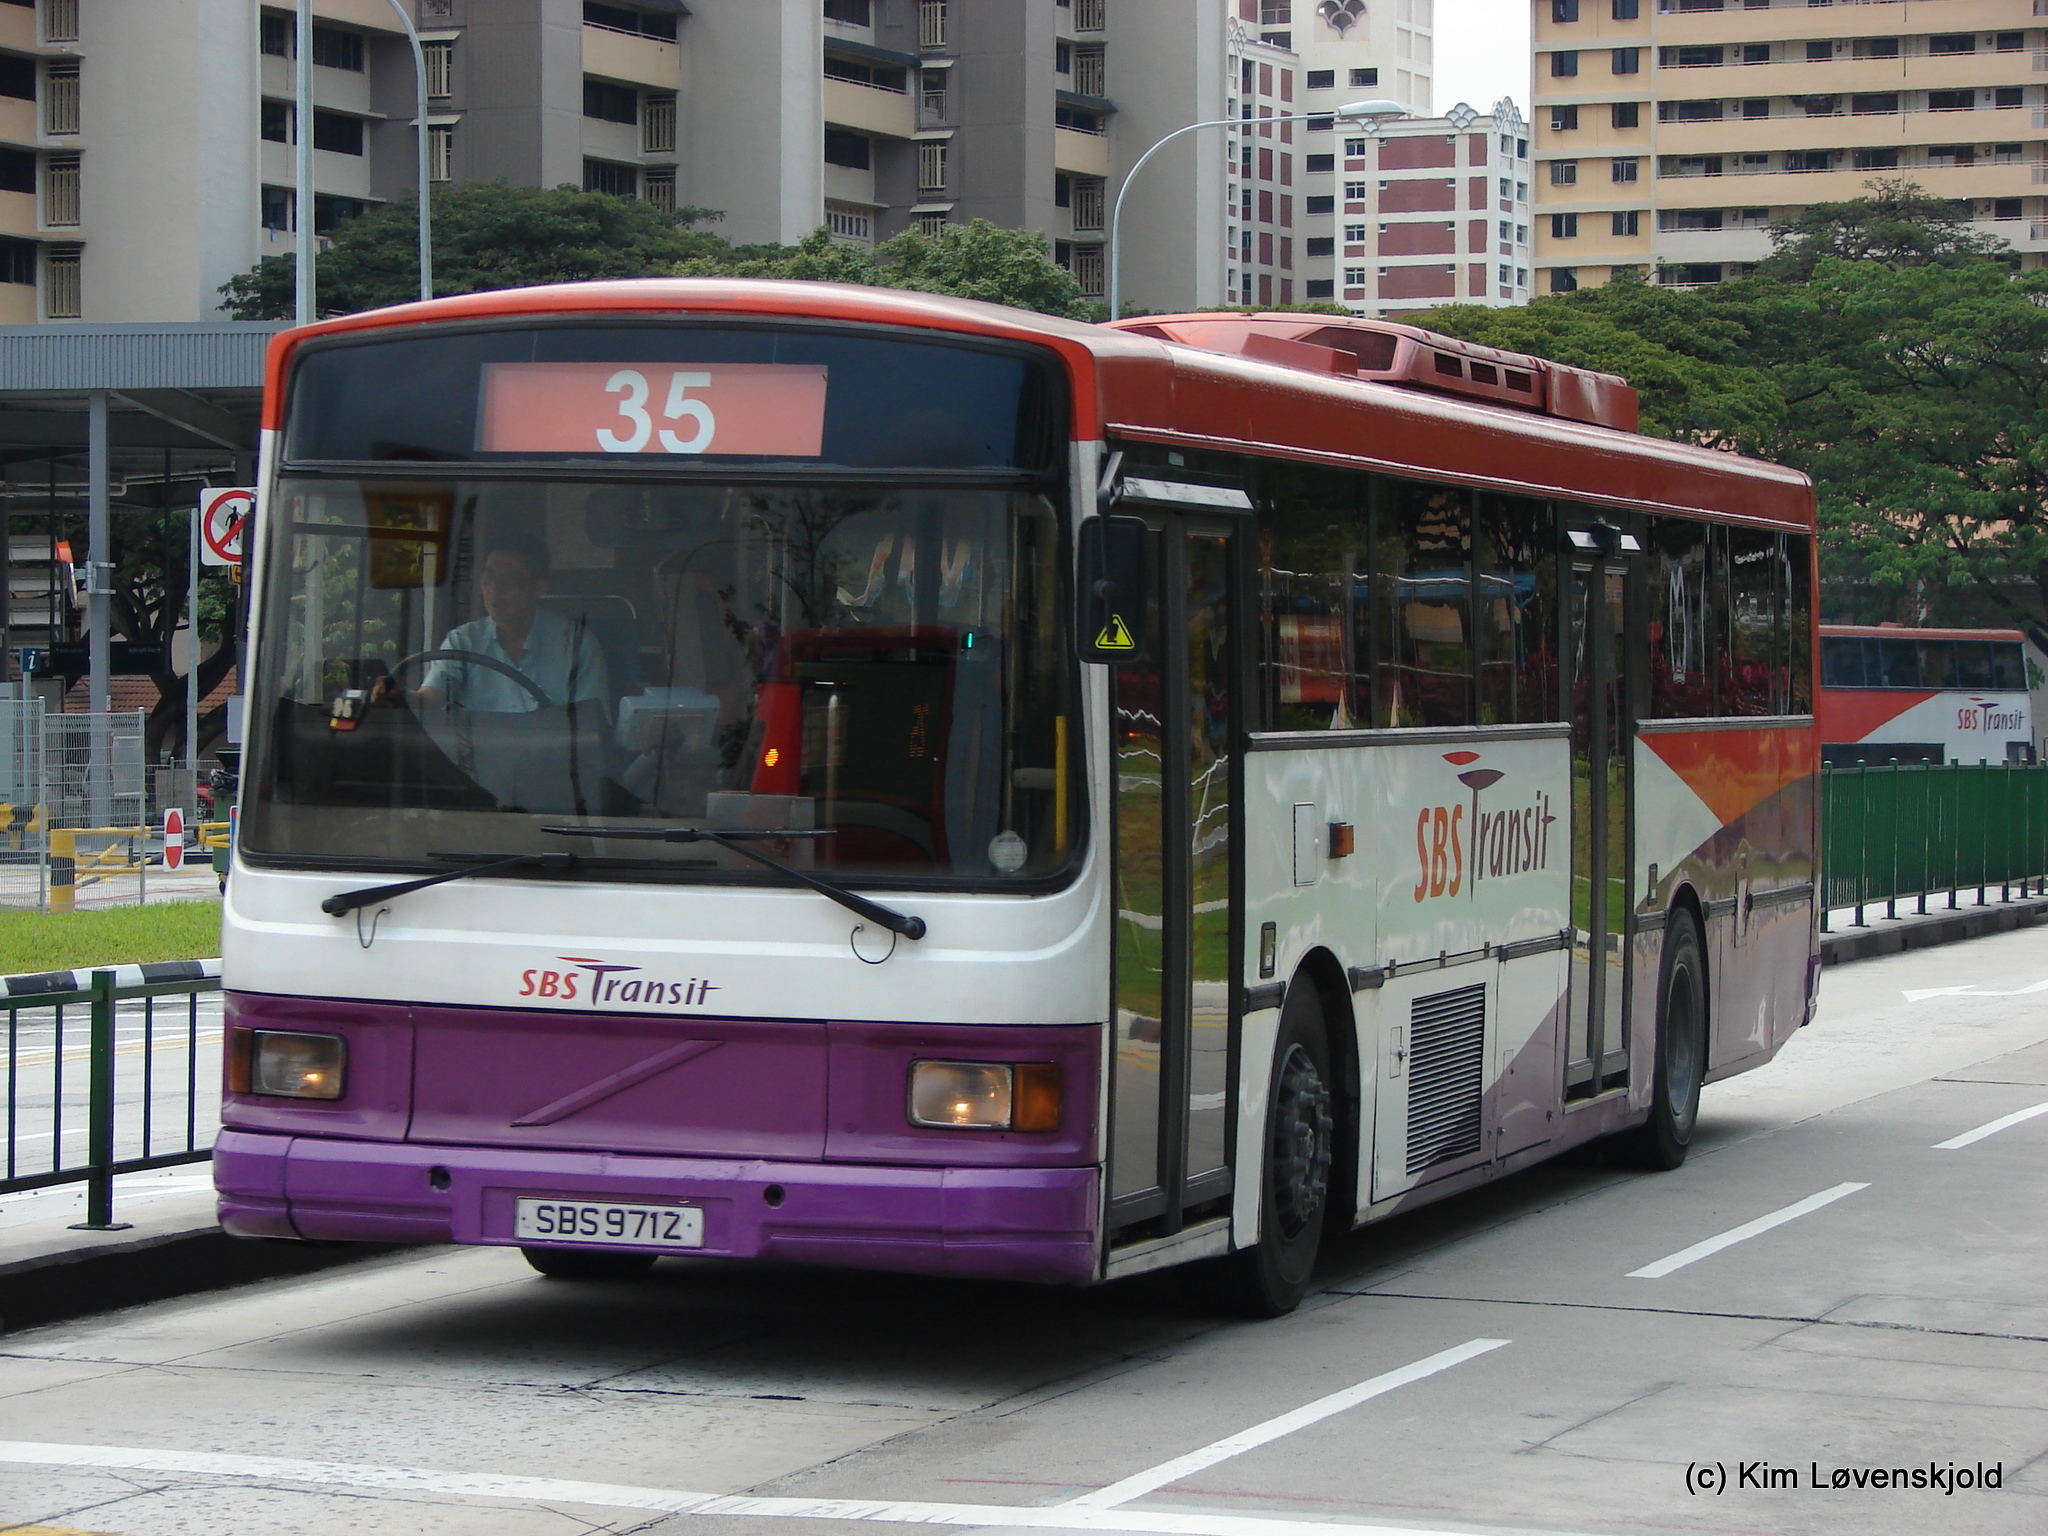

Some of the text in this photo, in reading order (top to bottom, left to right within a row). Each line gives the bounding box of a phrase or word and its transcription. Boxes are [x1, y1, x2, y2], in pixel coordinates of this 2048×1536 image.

[596, 369, 716, 454] 35
[1956, 702, 2026, 735] SBS Transit
[1414, 768, 1557, 903] SBS Transit
[519, 964, 723, 1006] SBS Transit
